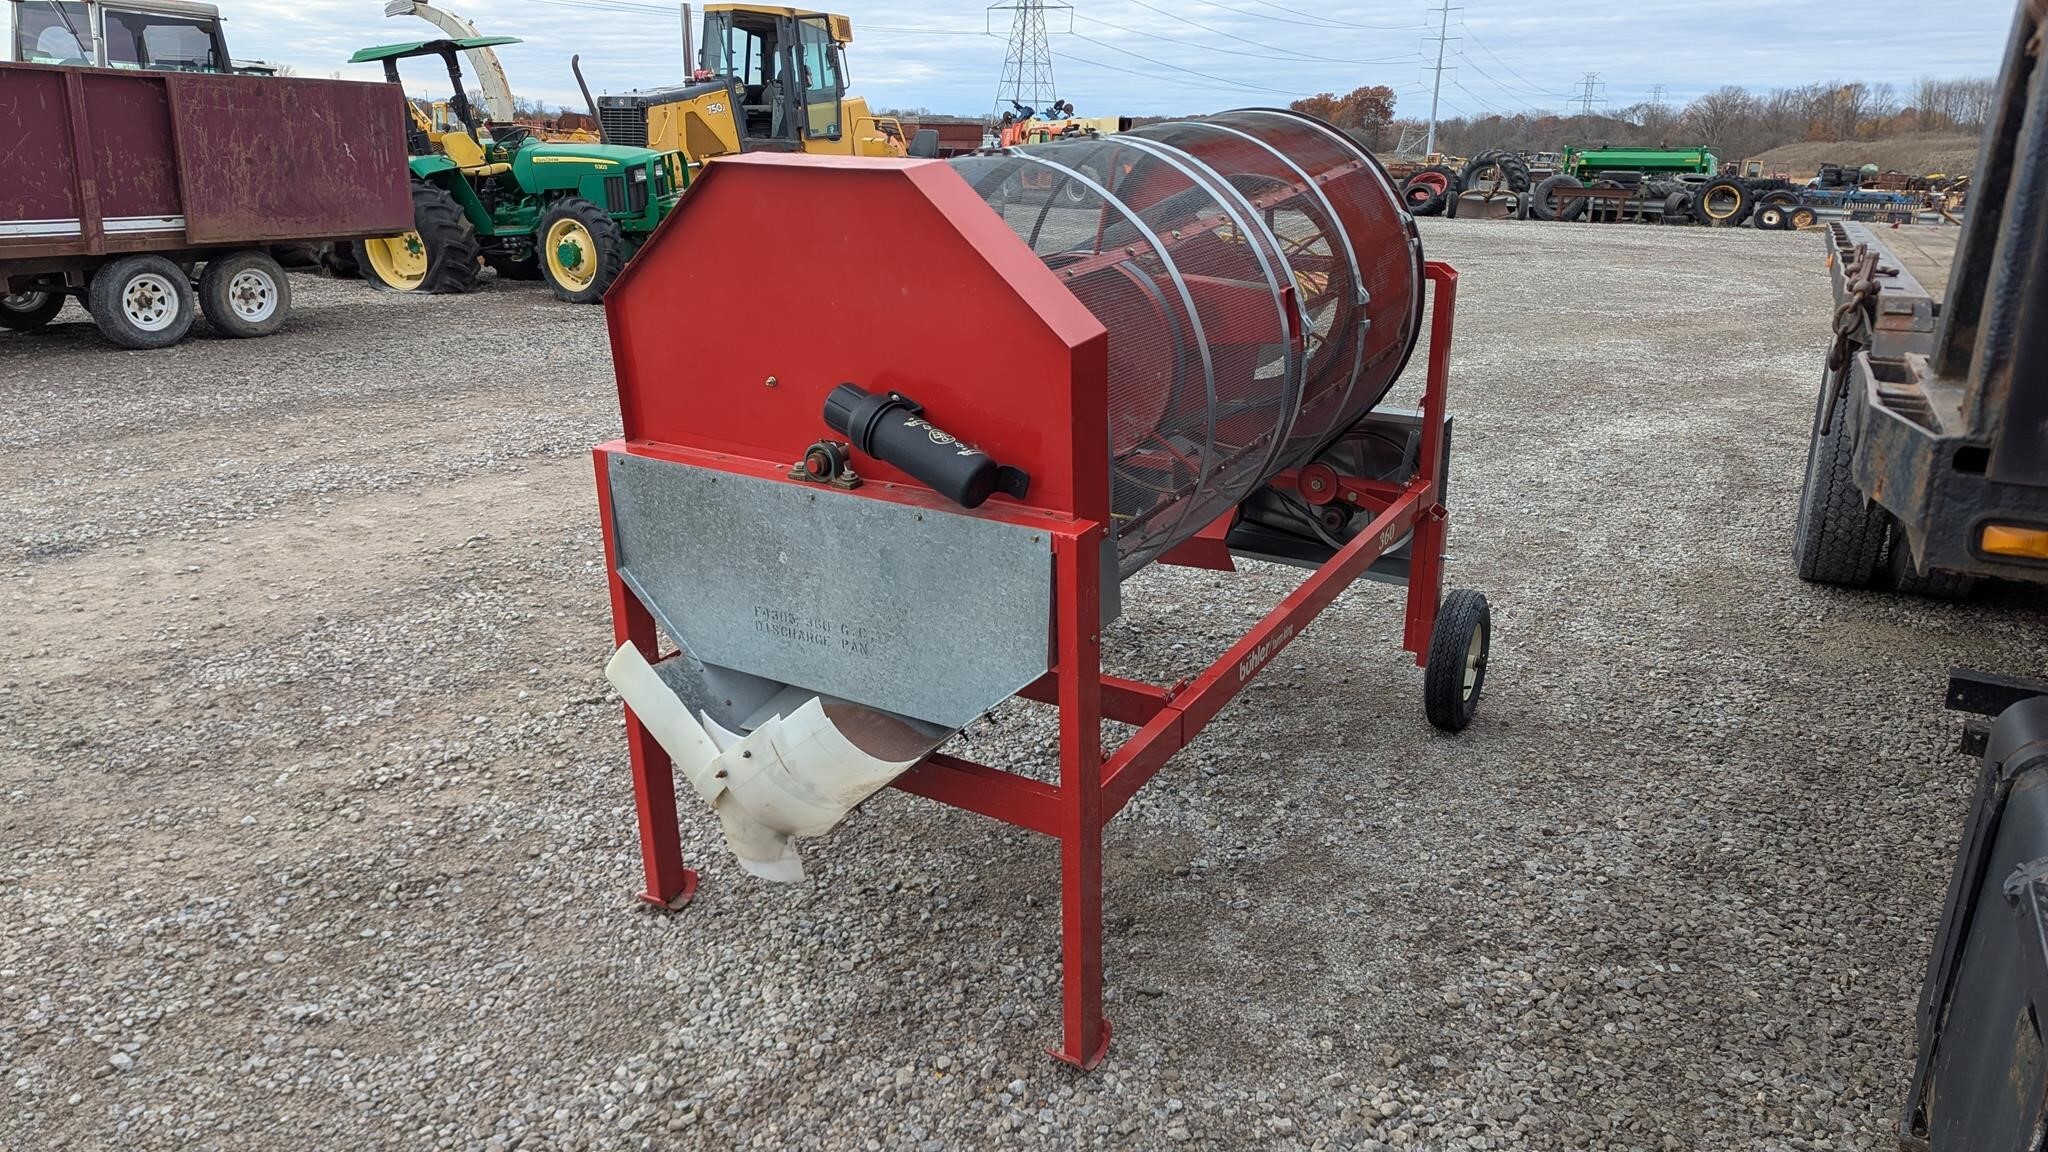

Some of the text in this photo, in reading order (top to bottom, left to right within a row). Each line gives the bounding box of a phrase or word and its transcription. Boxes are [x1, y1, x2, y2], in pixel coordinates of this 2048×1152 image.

[1379, 523, 1395, 550] 360
[755, 620, 868, 656] DISCHARGE PAN
